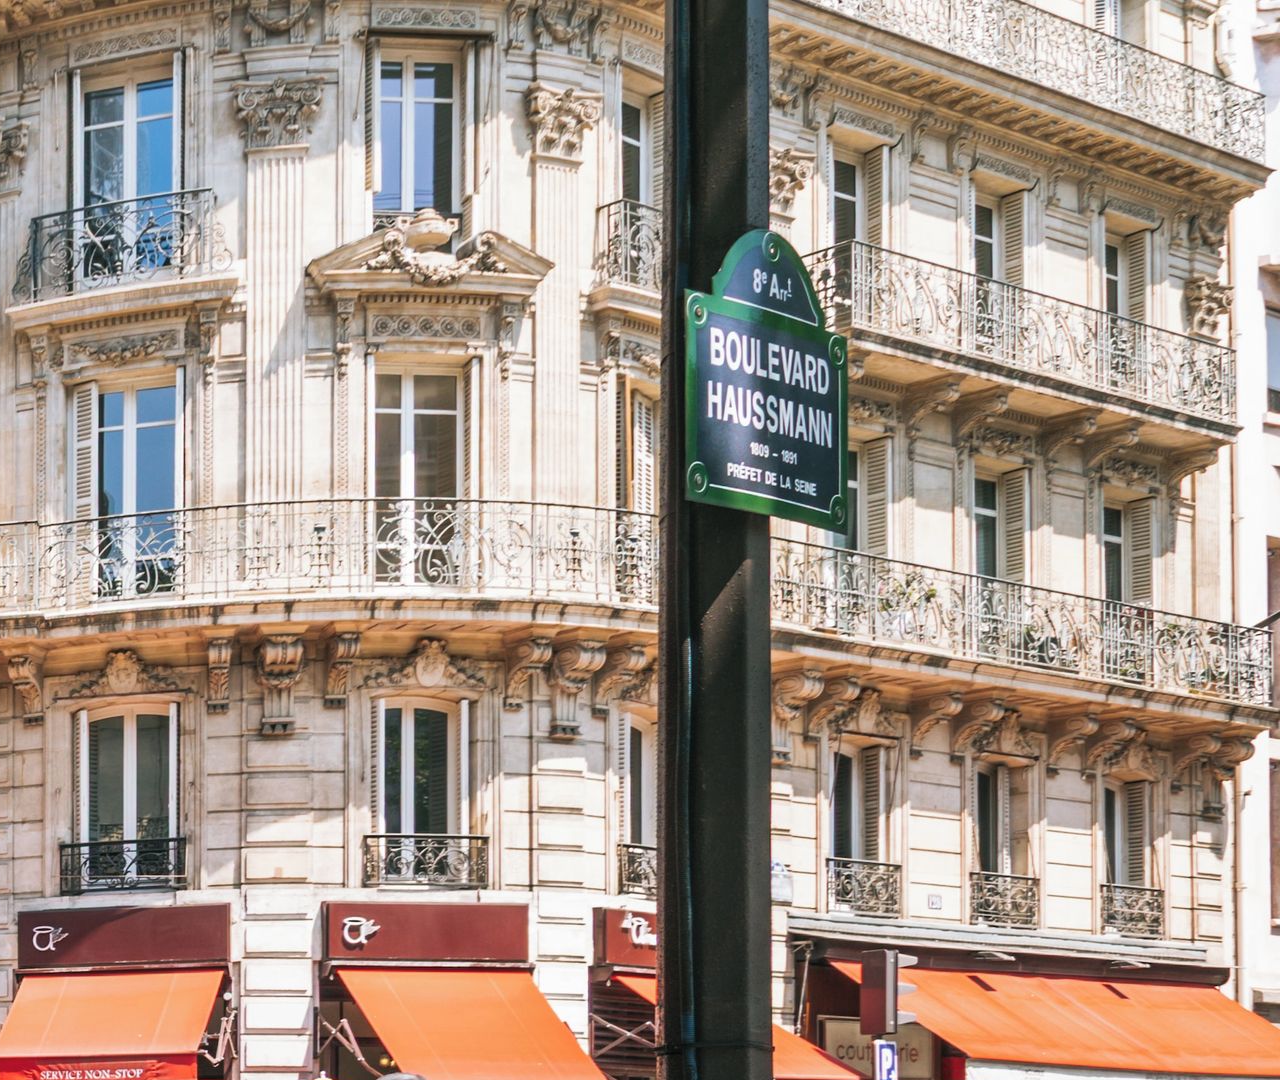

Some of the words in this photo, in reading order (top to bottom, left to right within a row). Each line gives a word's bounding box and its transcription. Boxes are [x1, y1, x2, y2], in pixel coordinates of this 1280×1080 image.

[709, 326, 830, 395] BOULEVARD
[706, 380, 833, 449] HAUSSMANN
[749, 441, 770, 459] 1809
[780, 449, 798, 466] 1891
[726, 461, 762, 484] PRÉFET
[764, 470, 778, 487] DE
[779, 475, 792, 490] LA
[794, 477, 818, 497] SEINE
[40, 1069, 83, 1080] SERVICE
[84, 1068, 145, 1080] NON-STOP
[880, 1047, 893, 1080] P
